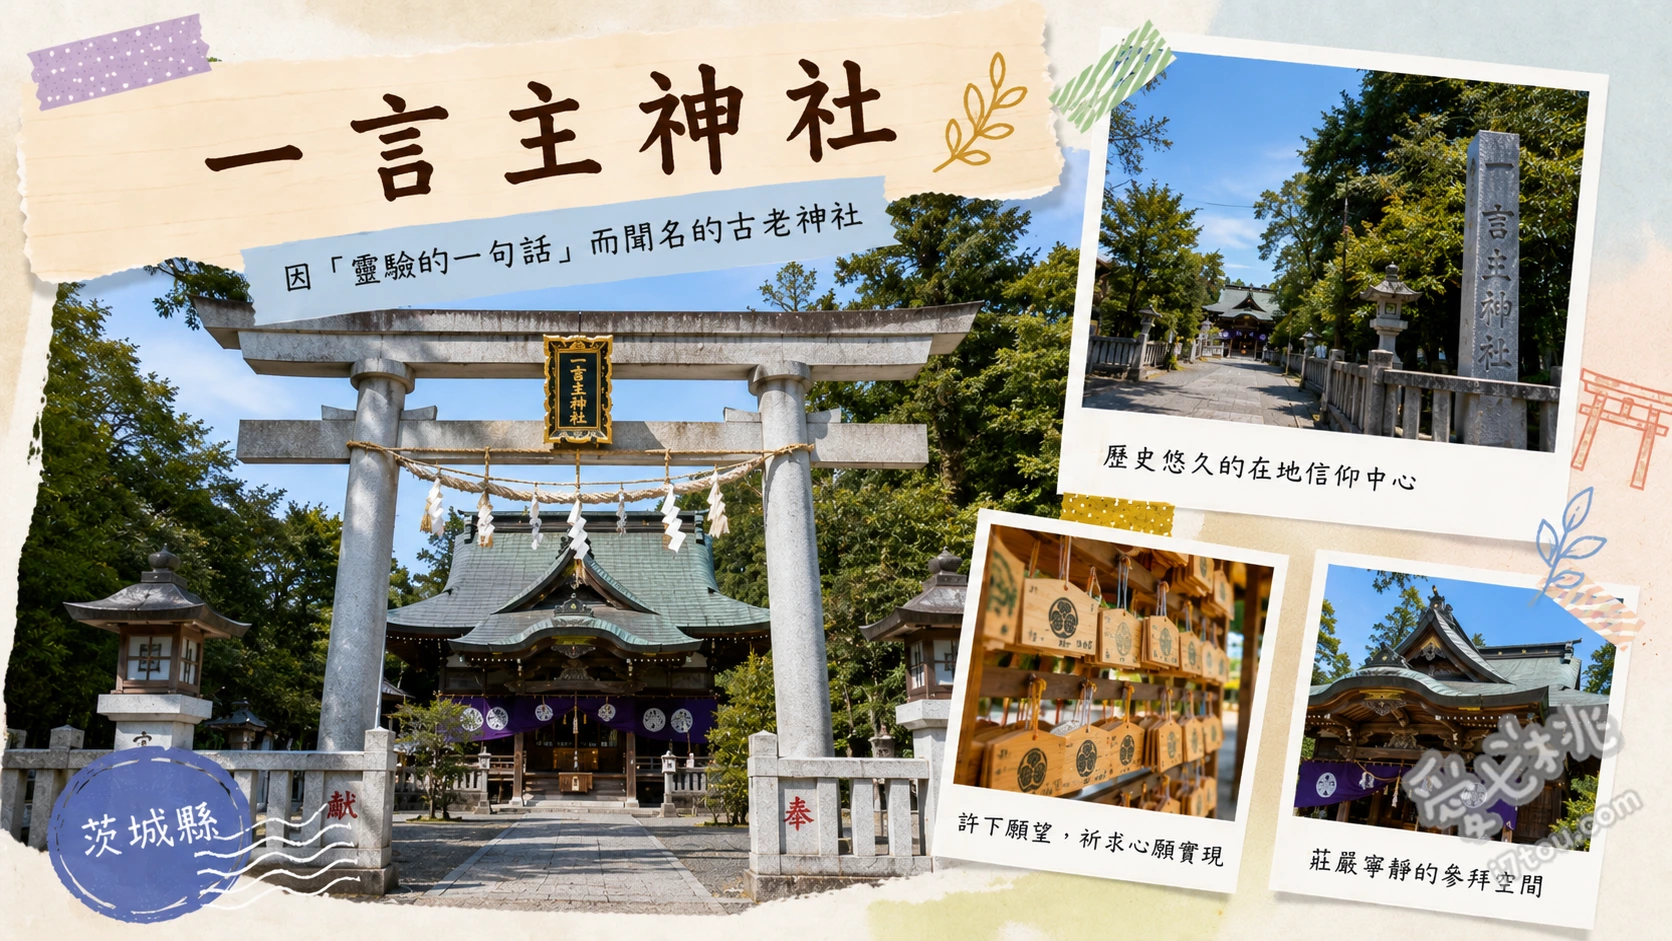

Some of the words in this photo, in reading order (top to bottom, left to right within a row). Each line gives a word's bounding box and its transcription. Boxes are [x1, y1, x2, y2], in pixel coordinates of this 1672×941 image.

[1478, 162, 1514, 372] 一言主神社
[783, 795, 815, 831] 奉
